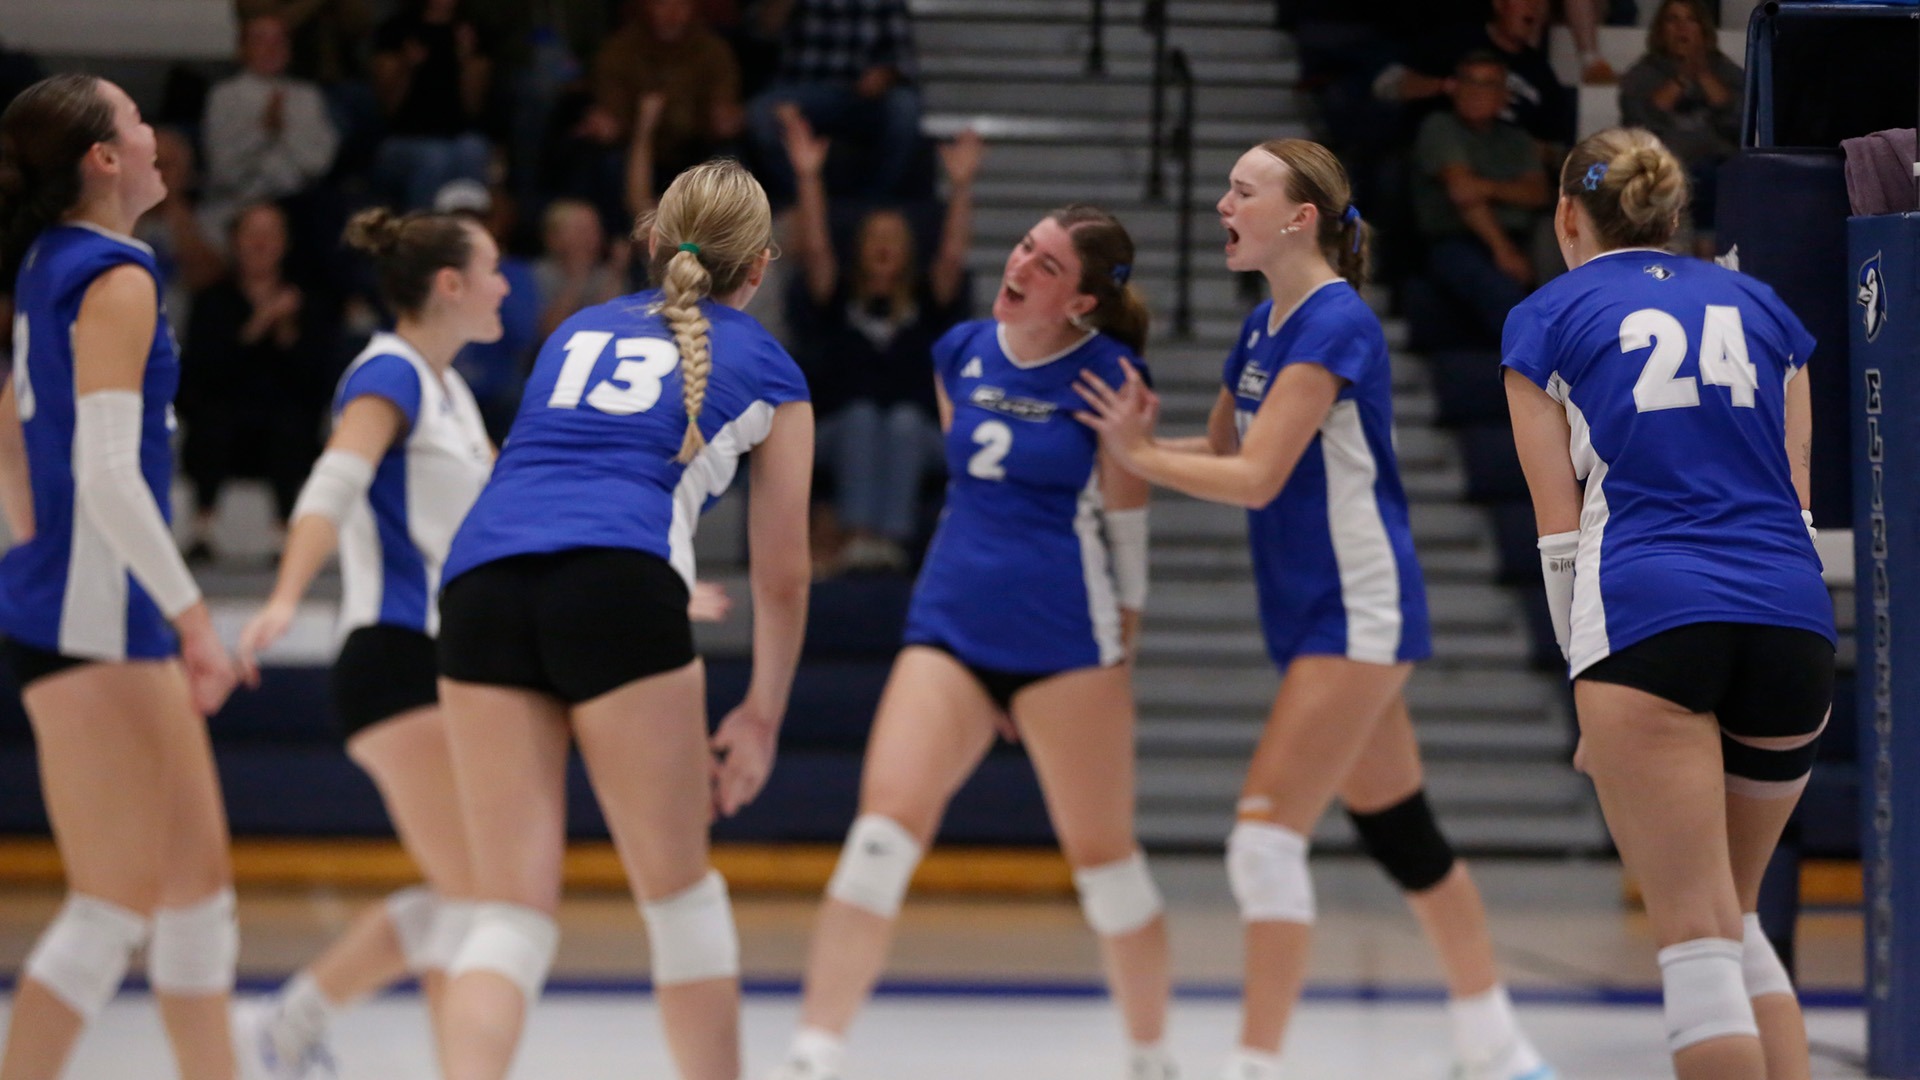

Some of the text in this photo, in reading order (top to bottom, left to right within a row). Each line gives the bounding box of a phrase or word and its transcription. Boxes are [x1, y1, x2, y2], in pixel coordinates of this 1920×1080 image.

[547, 330, 680, 416] 13
[1618, 303, 1759, 413] 24
[967, 418, 1014, 481] 2
[1865, 368, 1893, 1000] ELIZABETT
